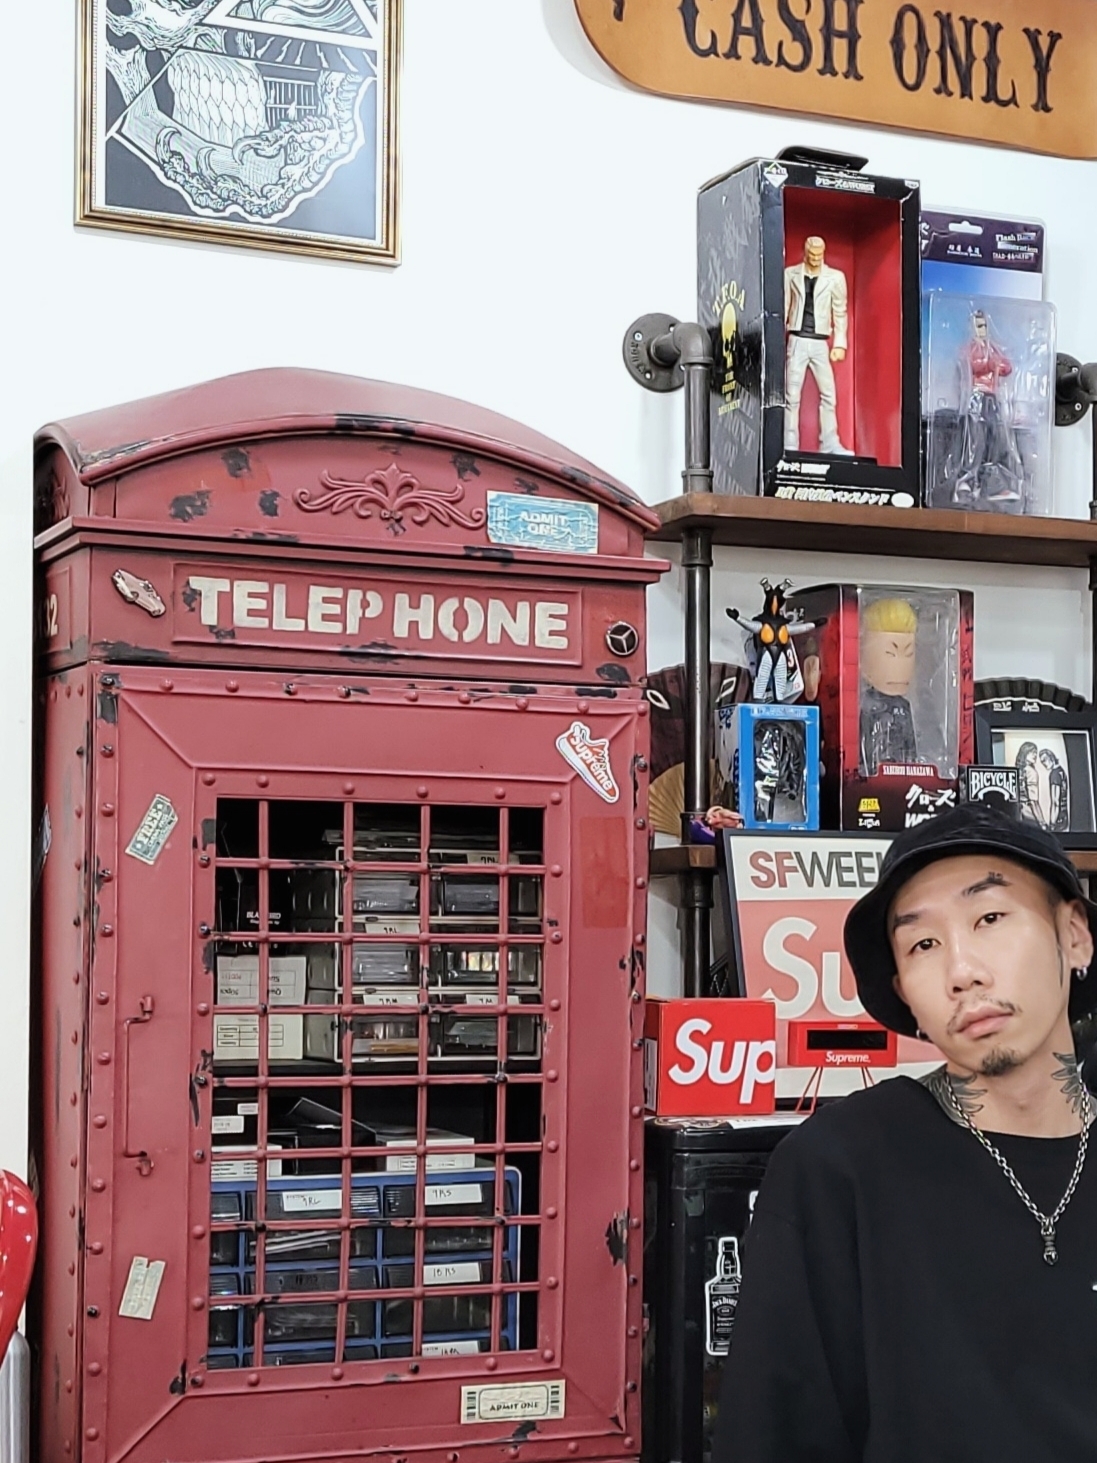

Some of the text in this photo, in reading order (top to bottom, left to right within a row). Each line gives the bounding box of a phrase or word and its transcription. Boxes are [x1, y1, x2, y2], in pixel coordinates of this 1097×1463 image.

[677, 0, 1064, 113] CASH ONLY
[520, 511, 568, 526] ADMIT
[527, 523, 559, 536] ONE
[189, 576, 569, 649] TELEPHONE
[570, 733, 613, 791] Supreme
[970, 771, 1017, 799] BICYCLE
[137, 808, 163, 845] FREE
[750, 851, 882, 889] SFWEE
[489, 1401, 539, 1412] ADMIT ONE
